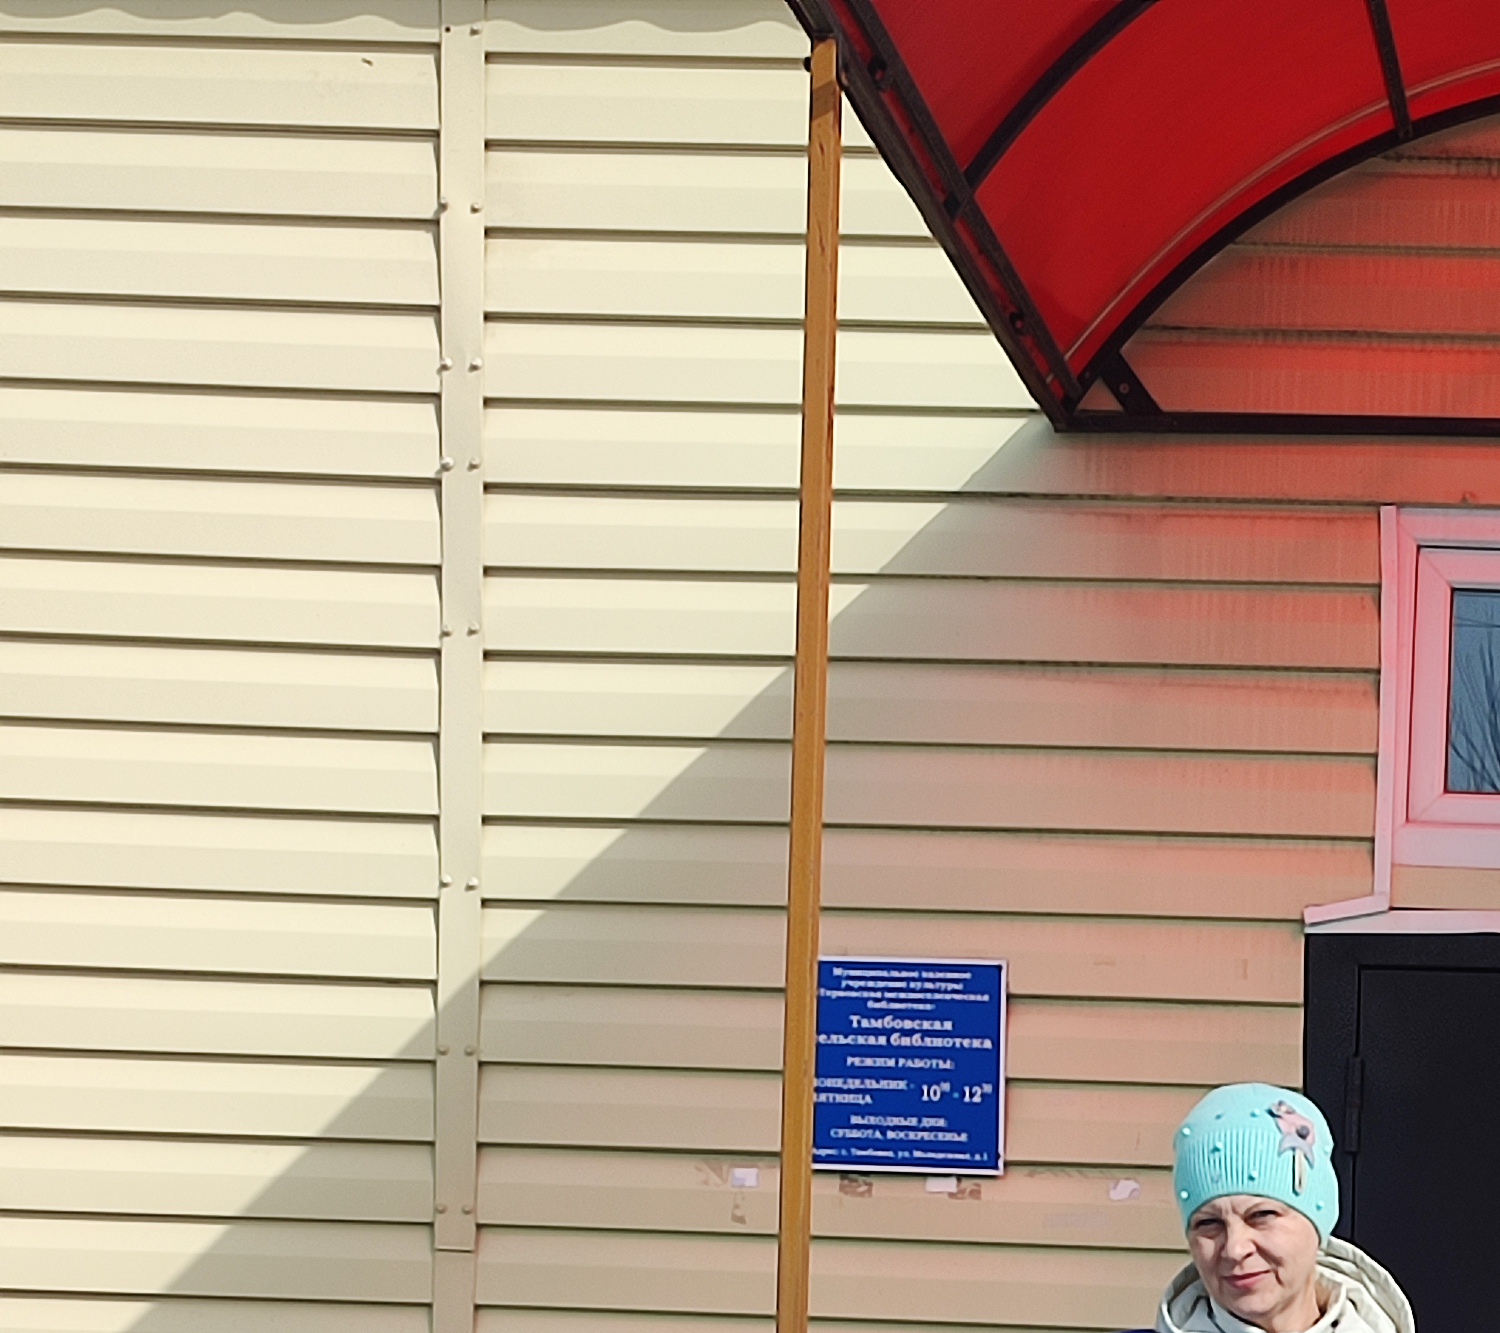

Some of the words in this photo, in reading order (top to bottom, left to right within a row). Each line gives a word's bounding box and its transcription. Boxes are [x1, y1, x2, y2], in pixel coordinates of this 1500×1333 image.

[849, 1014, 953, 1031] Тамбовская
[816, 1033, 887, 1046] ельская
[889, 1032, 993, 1050] библиотека
